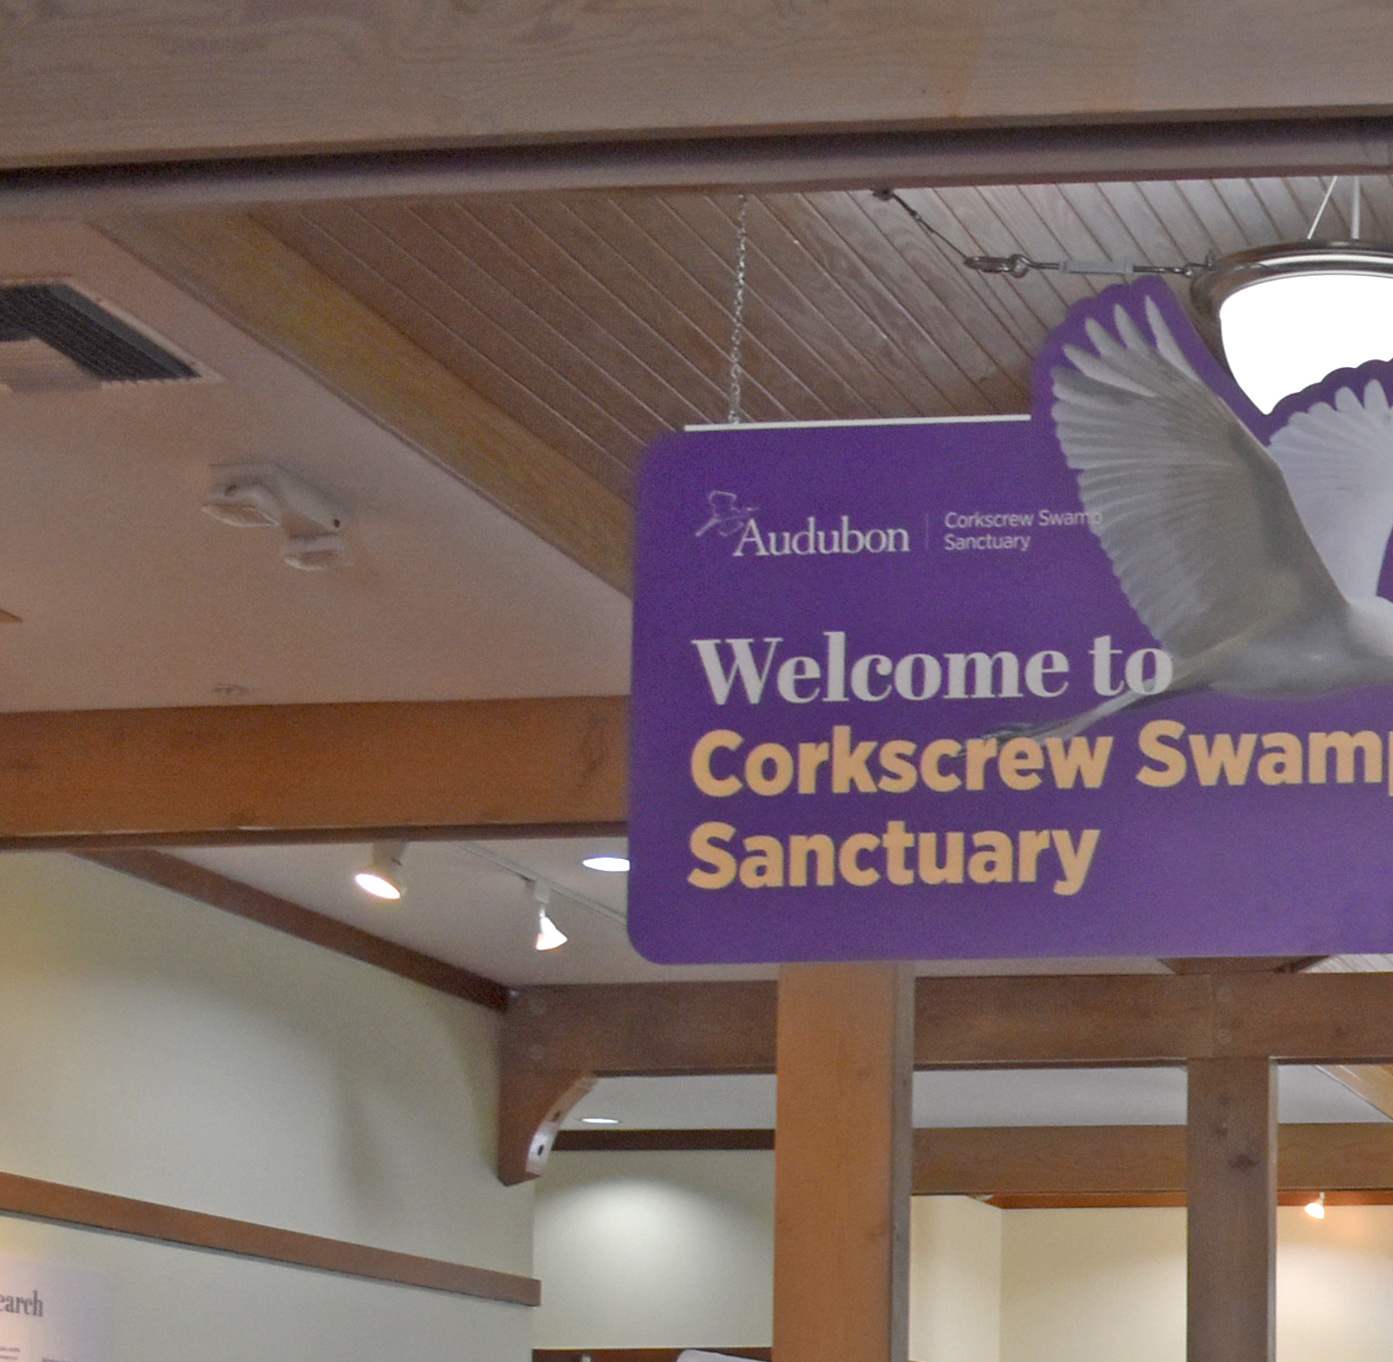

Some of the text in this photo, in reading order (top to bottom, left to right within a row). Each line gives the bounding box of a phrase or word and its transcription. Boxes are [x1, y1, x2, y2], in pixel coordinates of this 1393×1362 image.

[734, 517, 909, 557] Audubon
[945, 509, 1103, 529] Corkscrew Swamp
[945, 532, 1030, 551] Sanctuary
[694, 632, 1173, 706] Welcome to
[691, 726, 1113, 797] Corkscrew
[687, 821, 1101, 895] Sanctuary
